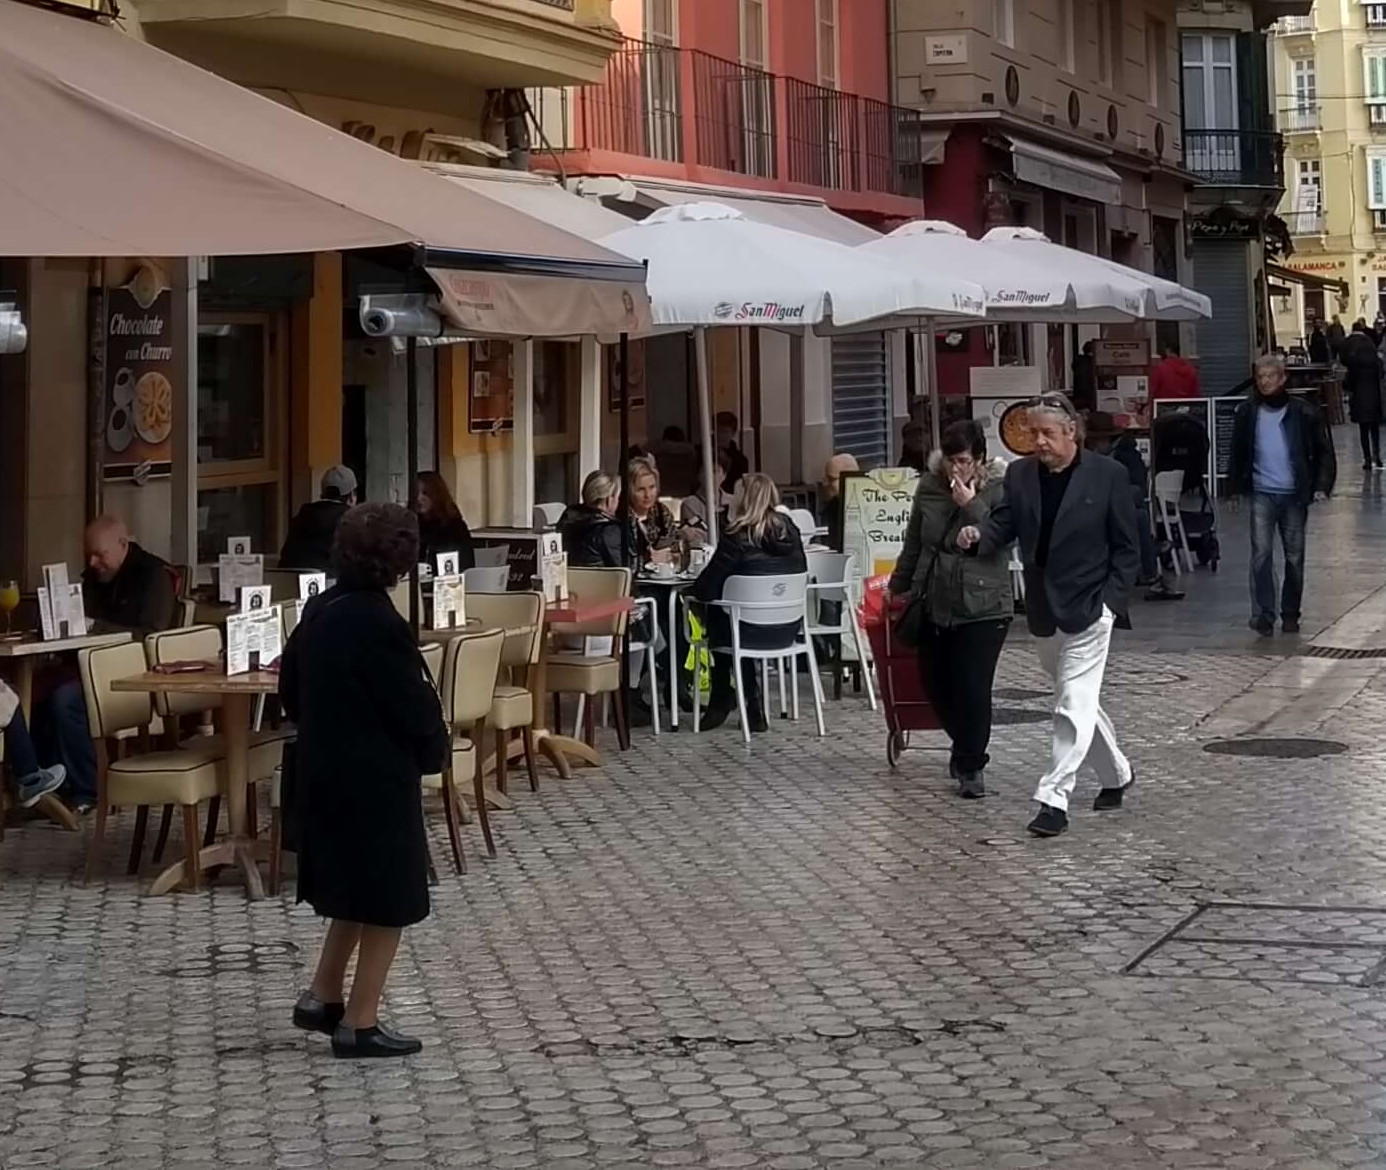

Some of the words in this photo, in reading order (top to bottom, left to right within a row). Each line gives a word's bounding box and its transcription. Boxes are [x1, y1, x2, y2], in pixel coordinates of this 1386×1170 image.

[110, 313, 164, 336] Chocolate
[862, 488, 888, 503] The
[876, 508, 910, 526] Engli
